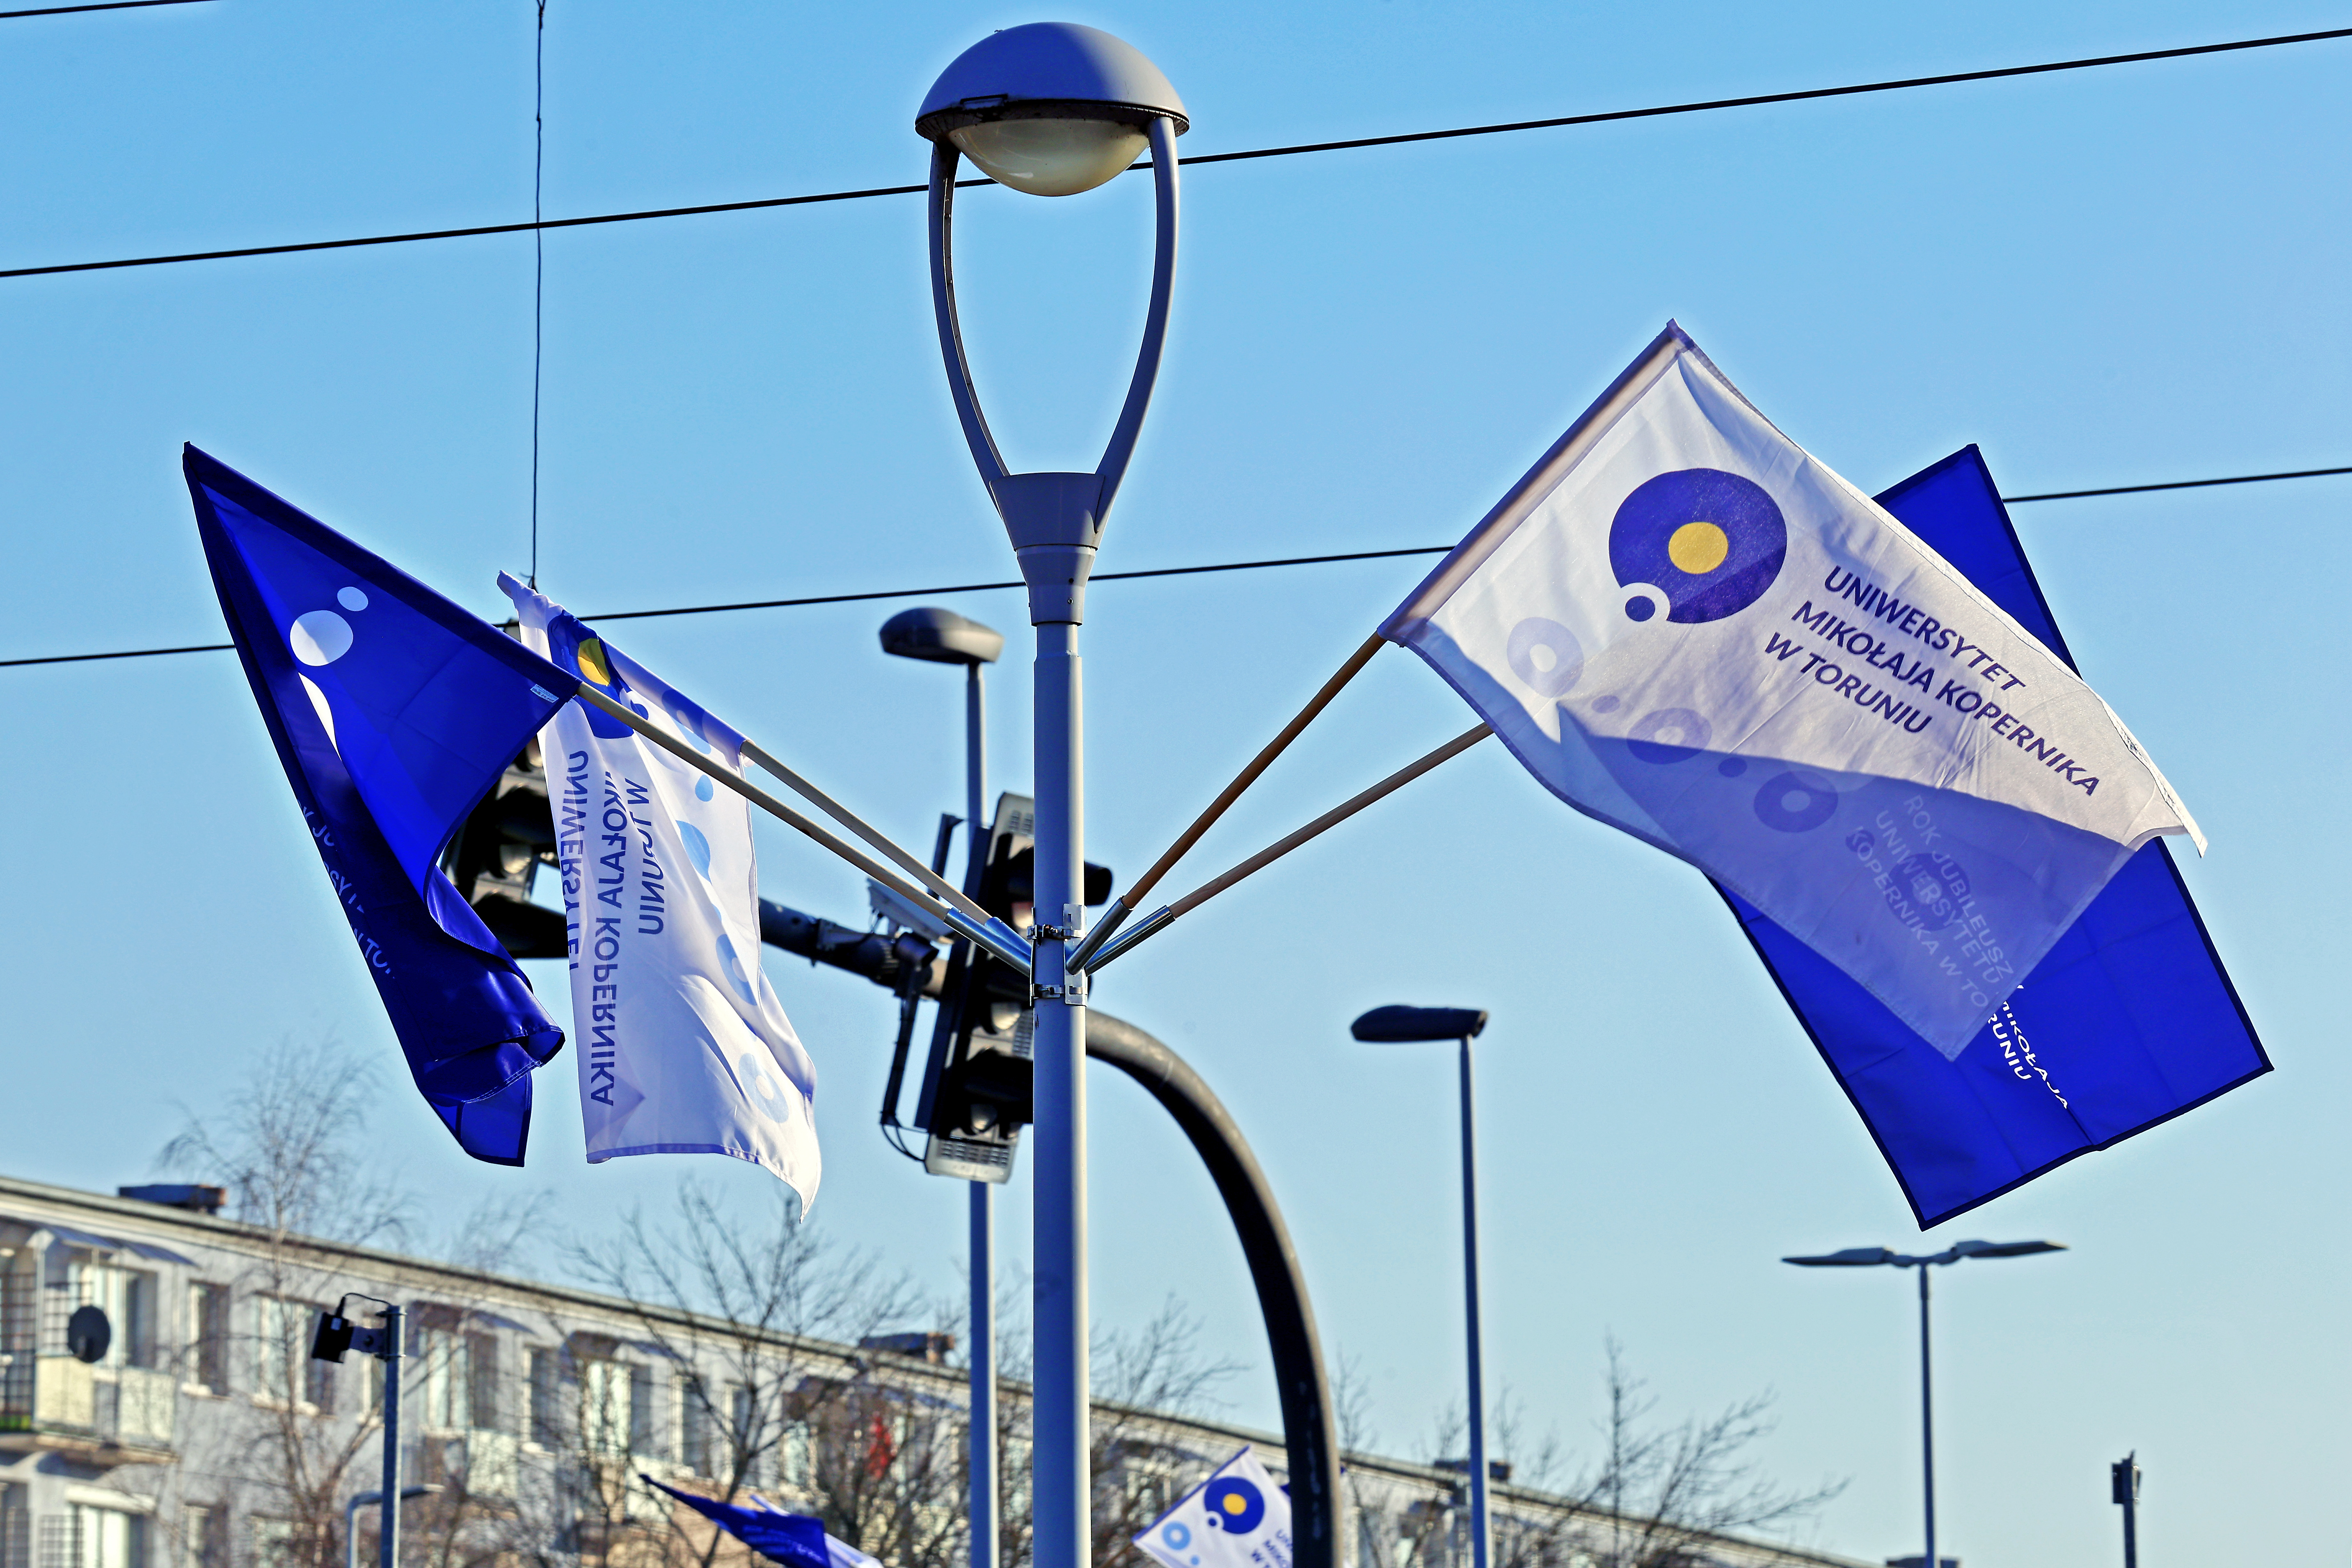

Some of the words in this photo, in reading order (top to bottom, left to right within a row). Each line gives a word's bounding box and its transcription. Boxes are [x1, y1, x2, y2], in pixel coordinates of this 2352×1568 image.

[1764, 632, 1803, 661] W
[1798, 652, 1933, 734] TORUNIU
[1791, 601, 1935, 693] MIKOŁAJA
[1936, 678, 2100, 797] KOPERNIKA
[1824, 565, 2026, 691] UNIWERSYTET
[1847, 826, 1940, 956] KOPERNIKA
[1939, 955, 1963, 976] W
[1876, 810, 2000, 984] UNIWERSYTETU
[1904, 795, 1941, 845] ROK
[1931, 851, 2024, 989] JUBILEUSZ
